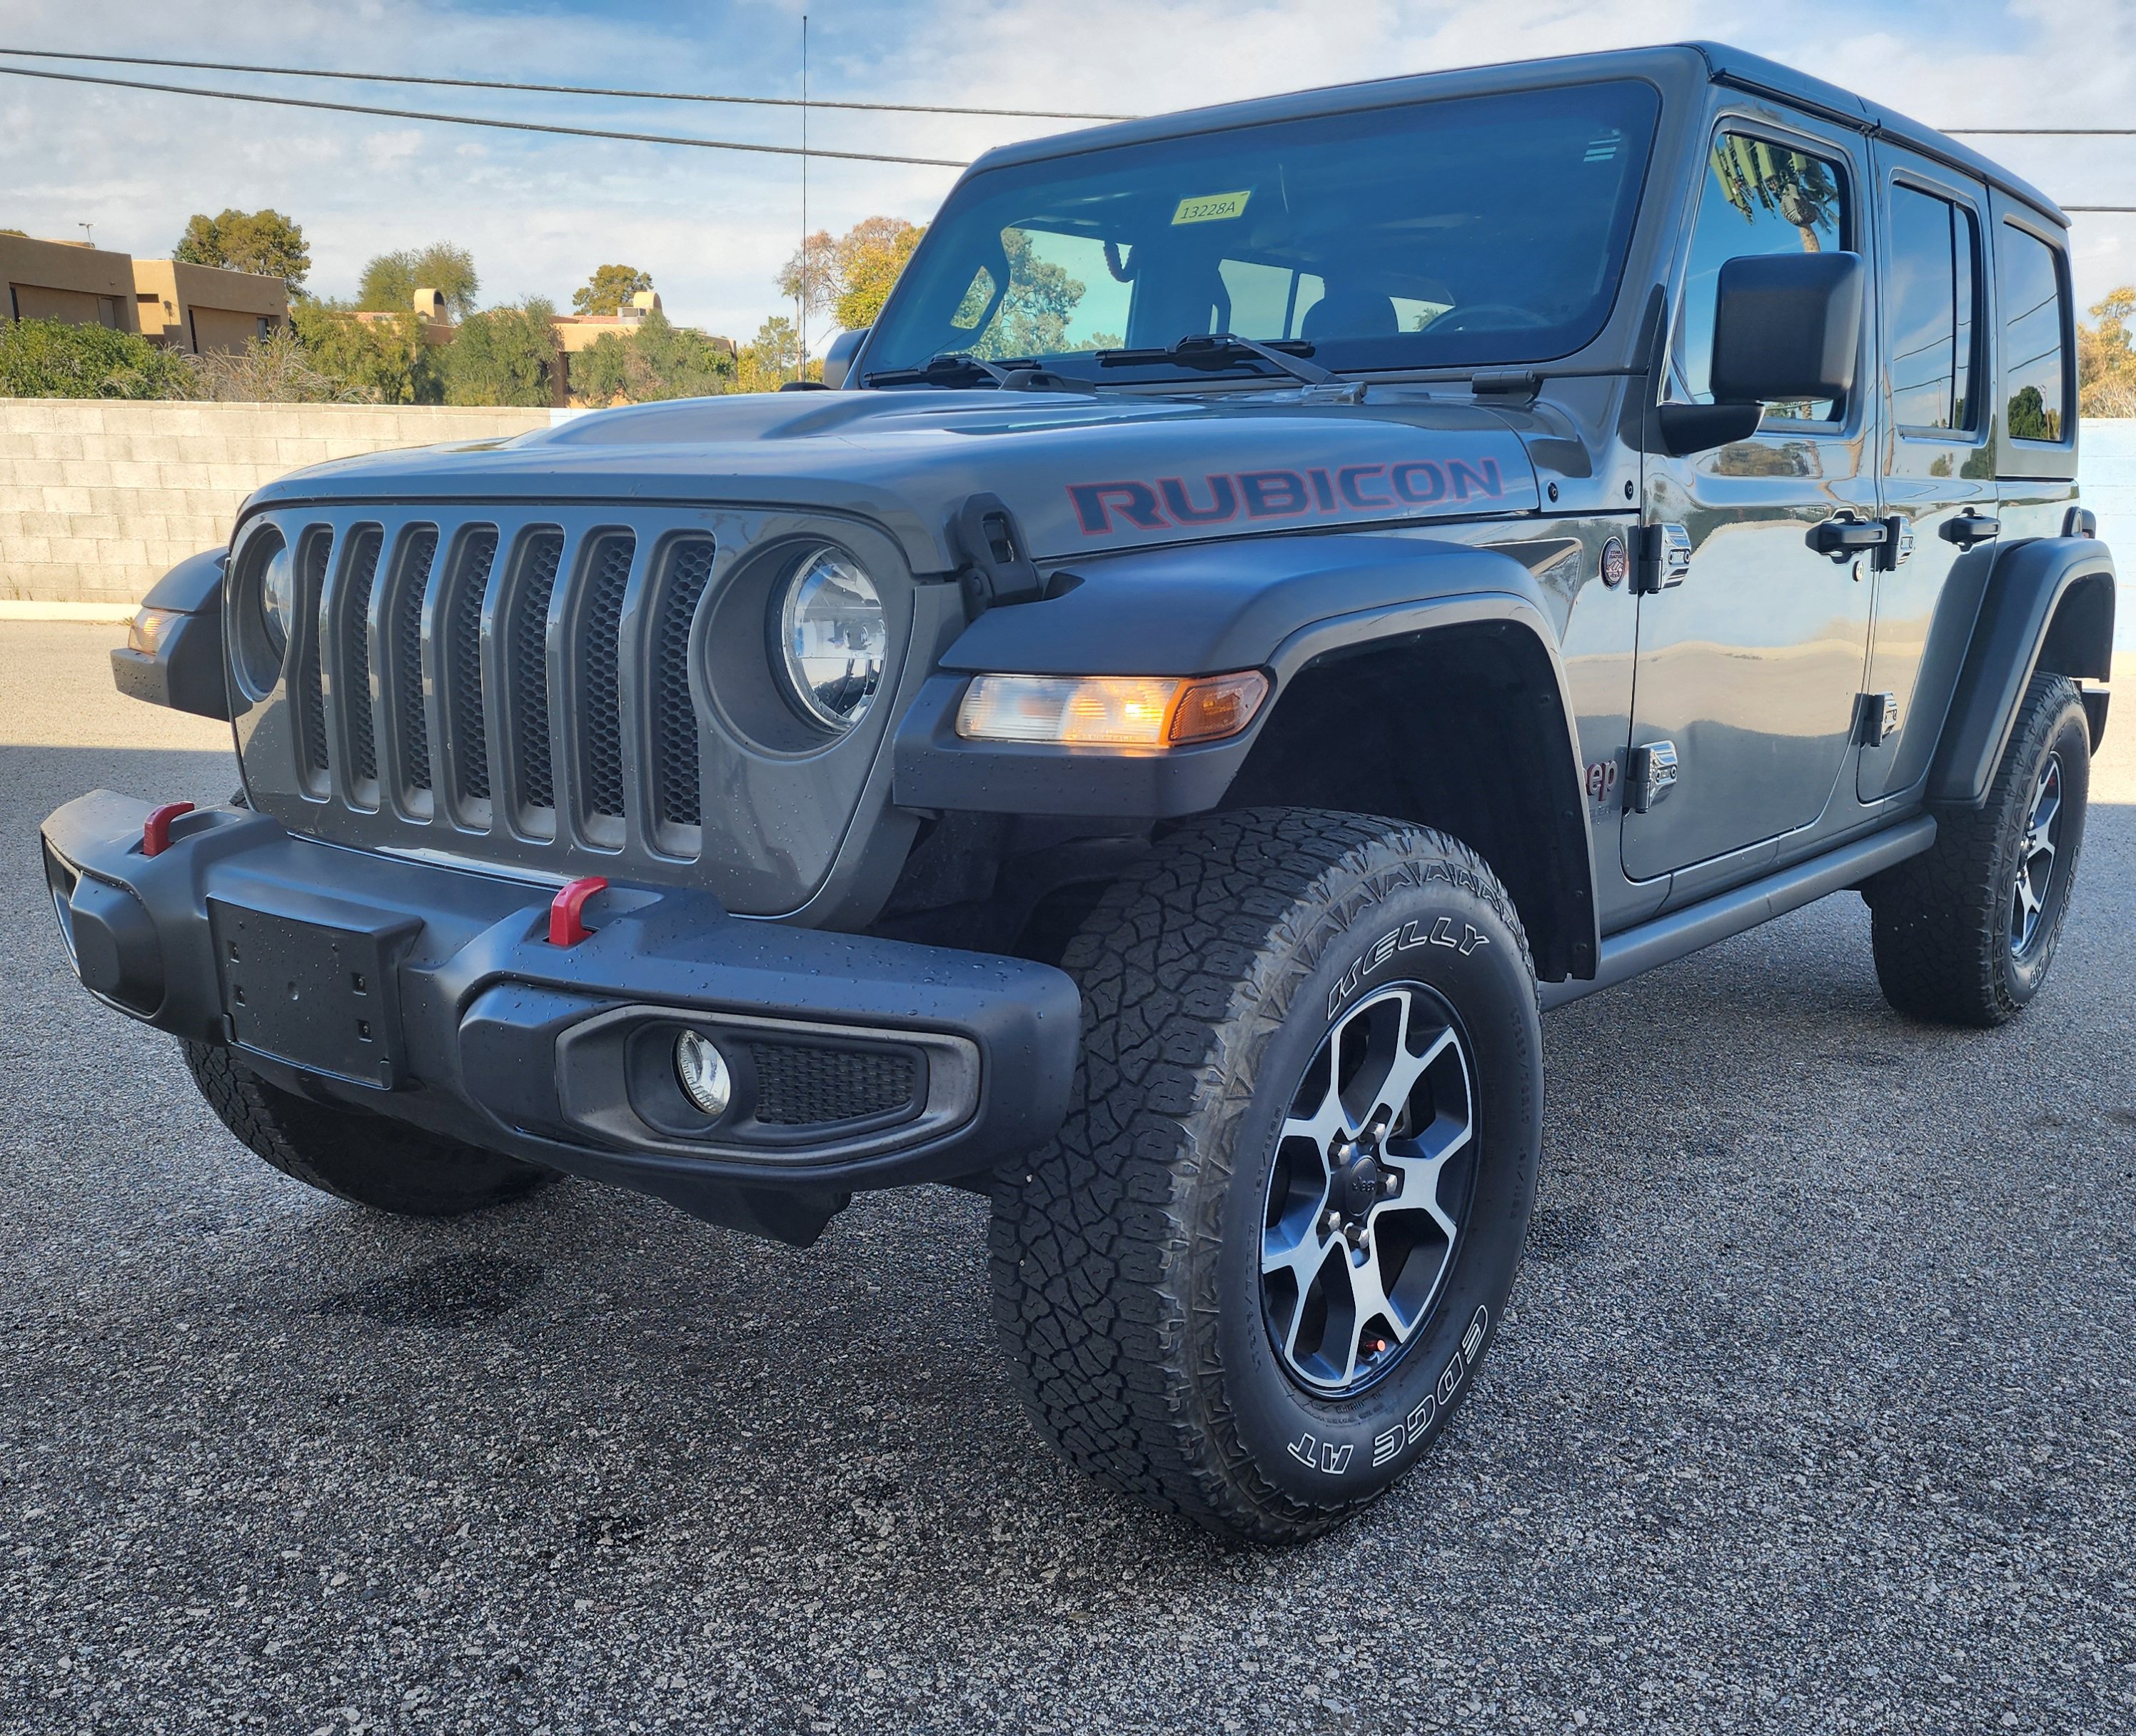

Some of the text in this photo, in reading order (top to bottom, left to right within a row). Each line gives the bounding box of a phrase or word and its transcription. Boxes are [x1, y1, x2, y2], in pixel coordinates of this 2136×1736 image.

[1180, 201, 1235, 219] 13228A
[1065, 457, 1505, 536] RUBICON
[1583, 760, 1618, 802] ep
[1326, 917, 1490, 1021] KELLY
[1286, 1304, 1489, 1475] EDGE AT
